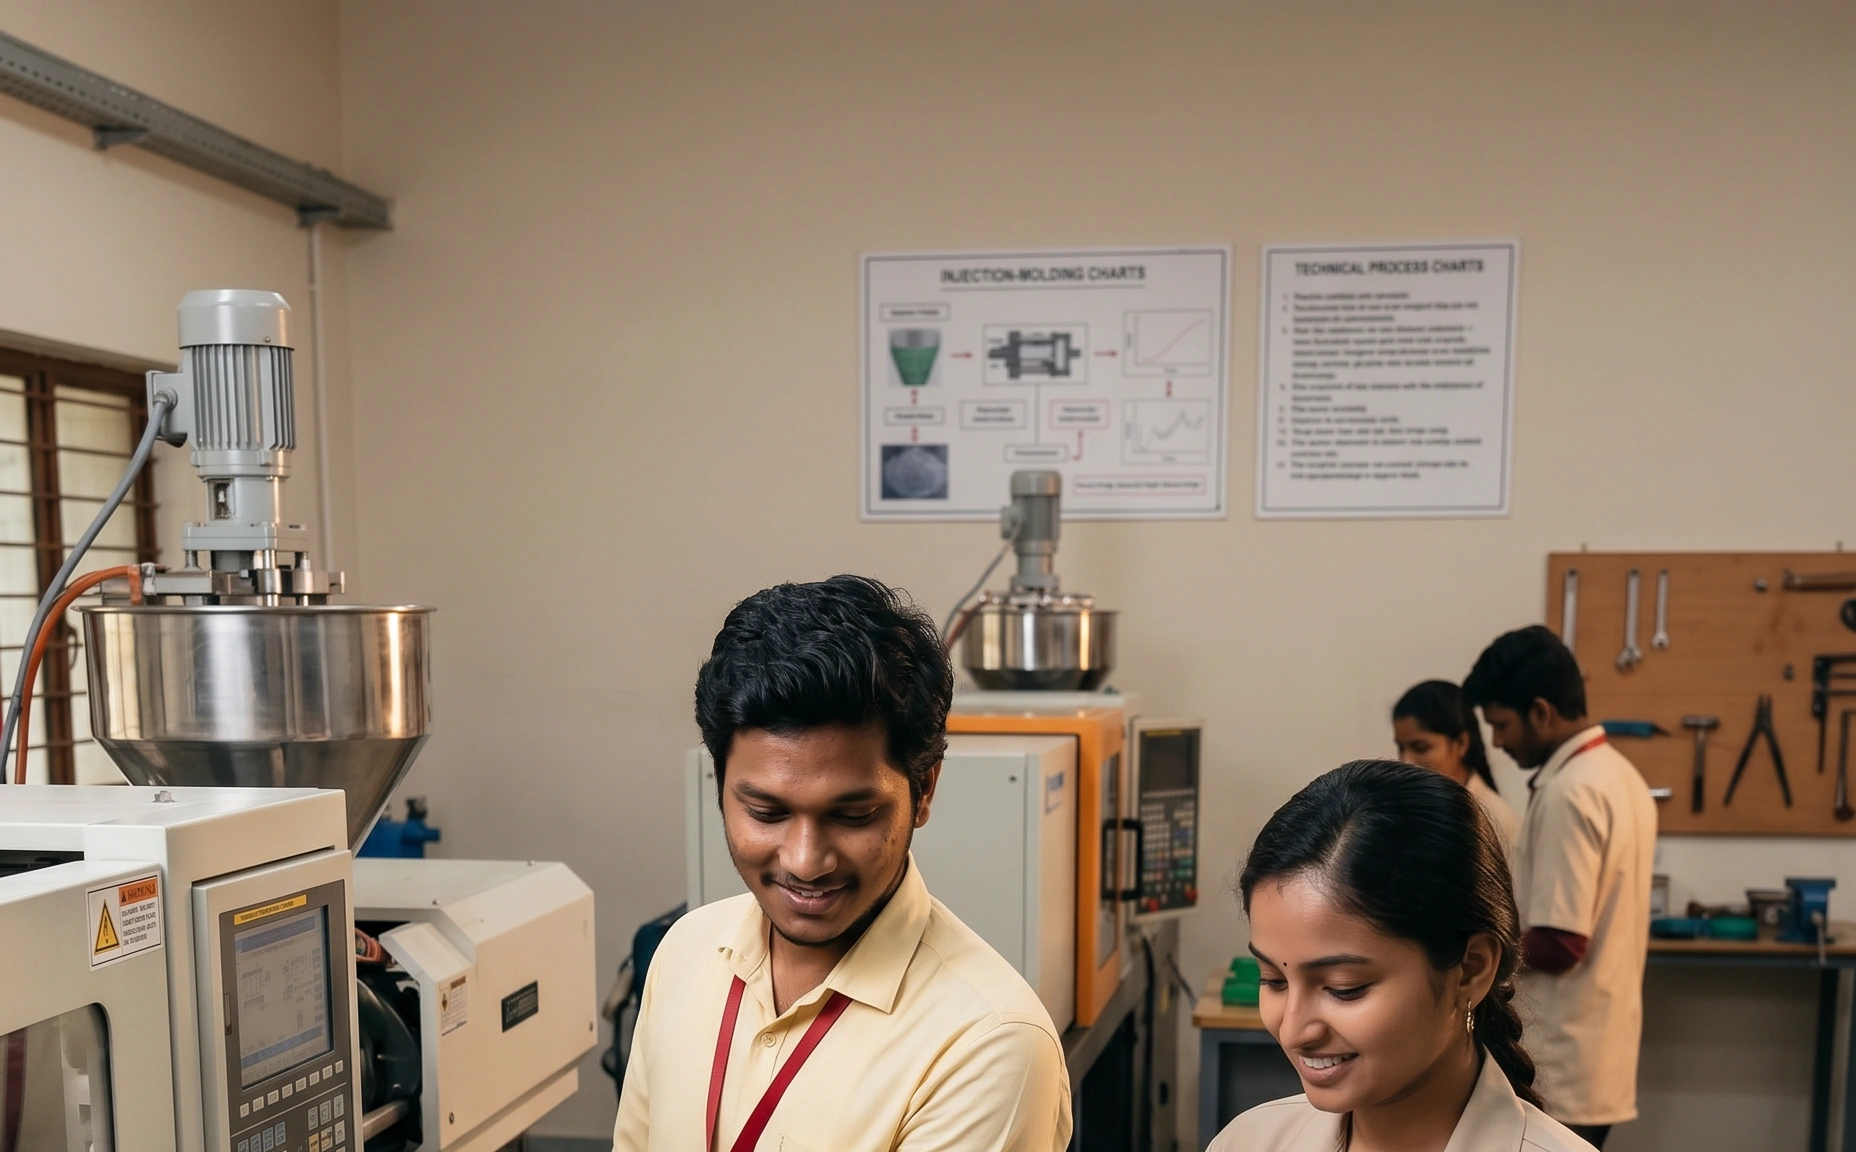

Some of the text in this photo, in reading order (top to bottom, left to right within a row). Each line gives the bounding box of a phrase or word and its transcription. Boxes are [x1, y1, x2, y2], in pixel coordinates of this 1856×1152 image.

[941, 265, 1146, 283] INJECTION-MOLDING CHARTS
[1295, 259, 1484, 275] TECHNICAL PROCESS CHARTS
